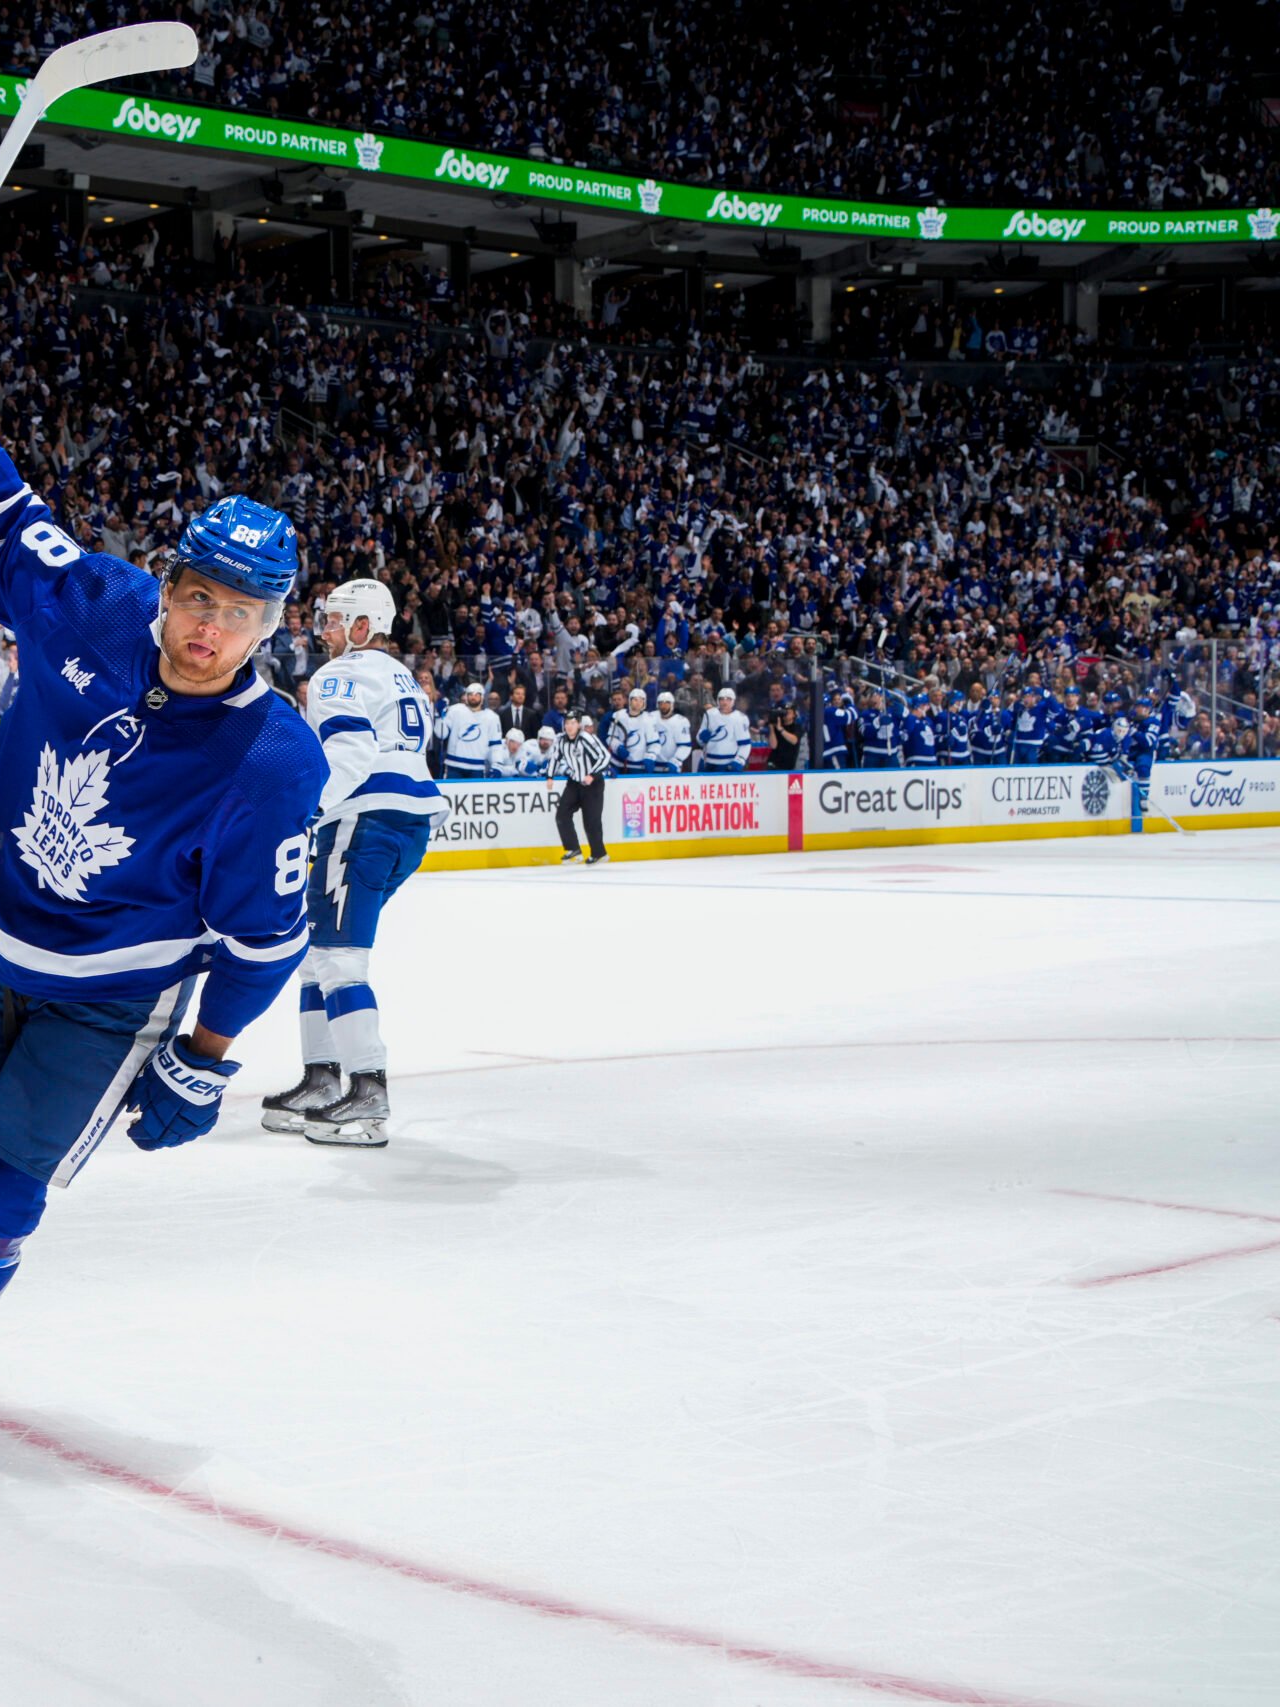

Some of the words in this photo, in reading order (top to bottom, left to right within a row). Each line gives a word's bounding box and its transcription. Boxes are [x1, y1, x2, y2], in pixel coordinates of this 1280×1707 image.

[112, 97, 202, 140] Sobeys
[225, 123, 278, 145] PROUD
[281, 132, 348, 156] PARTNER
[435, 148, 510, 187] Sobeys
[528, 171, 574, 193] PROUD
[576, 179, 632, 201] PARTNER
[706, 191, 784, 225] Sobeys
[802, 207, 849, 224] PROUD
[851, 211, 911, 229] PARTNER
[1003, 210, 1087, 241] Sobeys
[1108, 220, 1161, 234] PROUD
[1164, 219, 1239, 233] PARTNER
[21, 520, 82, 568] 8
[229, 524, 263, 549] 88
[213, 552, 253, 574] BAUER
[61, 656, 96, 694] Milk
[320, 676, 358, 700] 91
[396, 697, 432, 752] 9
[649, 784, 695, 801] CLEAN.
[700, 782, 760, 800] HEALTHY.
[818, 779, 898, 815] Great
[903, 778, 963, 820] Clips
[991, 775, 1073, 802] CITIZEN
[1164, 783, 1188, 796] BUILT
[1190, 768, 1247, 808] Ford
[1249, 781, 1276, 793] PROUD
[40, 790, 94, 863] TORONTO
[649, 801, 760, 834] HYDRATION.
[1016, 805, 1061, 816] PROMASTER
[32, 826, 72, 879] LEAFS
[40, 812, 79, 866] MAPLE
[70, 1116, 105, 1164] BAUER
